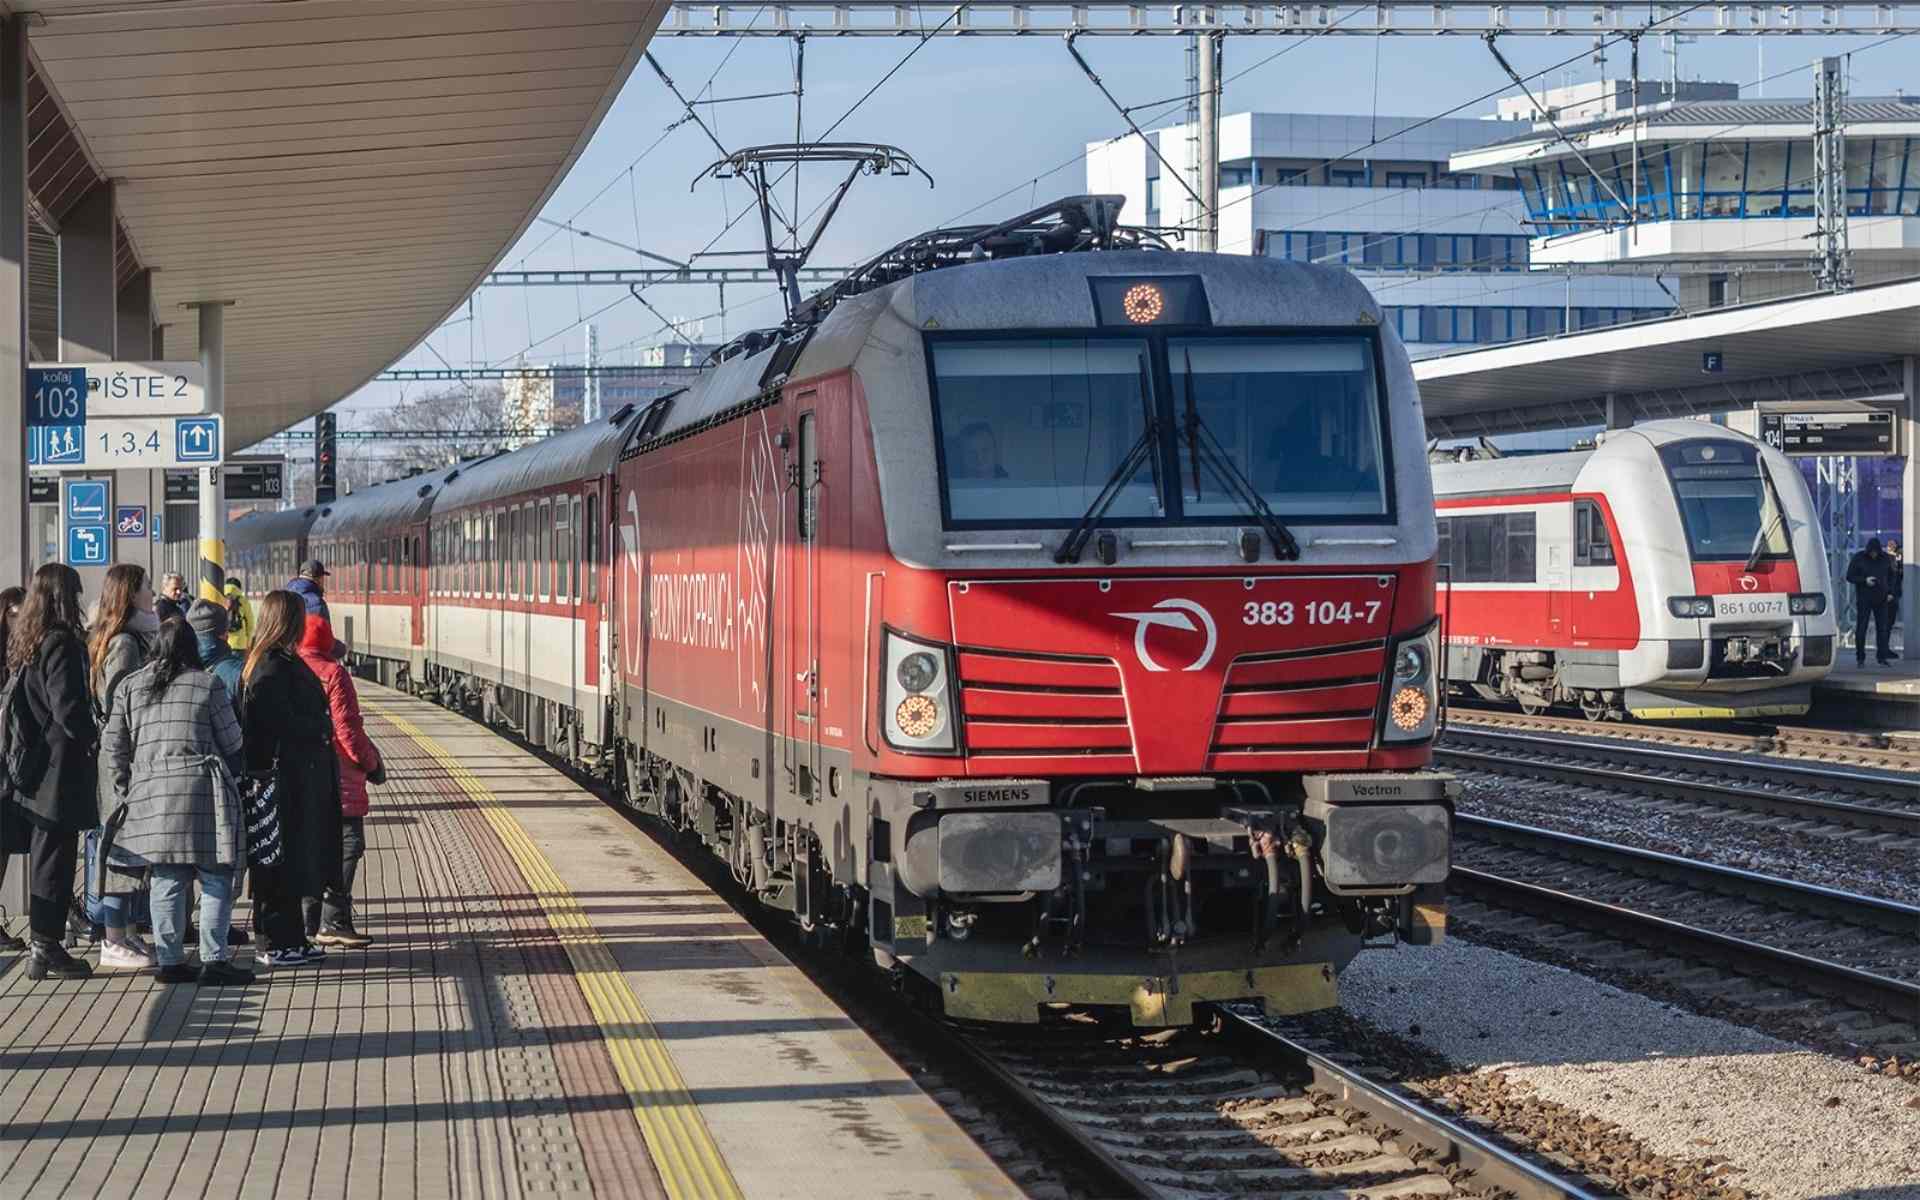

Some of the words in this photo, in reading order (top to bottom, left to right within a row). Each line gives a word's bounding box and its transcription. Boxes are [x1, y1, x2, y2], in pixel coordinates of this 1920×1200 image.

[174, 375, 189, 397] 2
[34, 387, 79, 419] 103
[1242, 601, 1295, 626] 383
[1304, 601, 1382, 625] 104-7
[1720, 603, 1745, 615] 861
[1748, 601, 1783, 614] 007-7
[963, 788, 1030, 803] SIEMENS
[1351, 783, 1402, 797] Vectron
